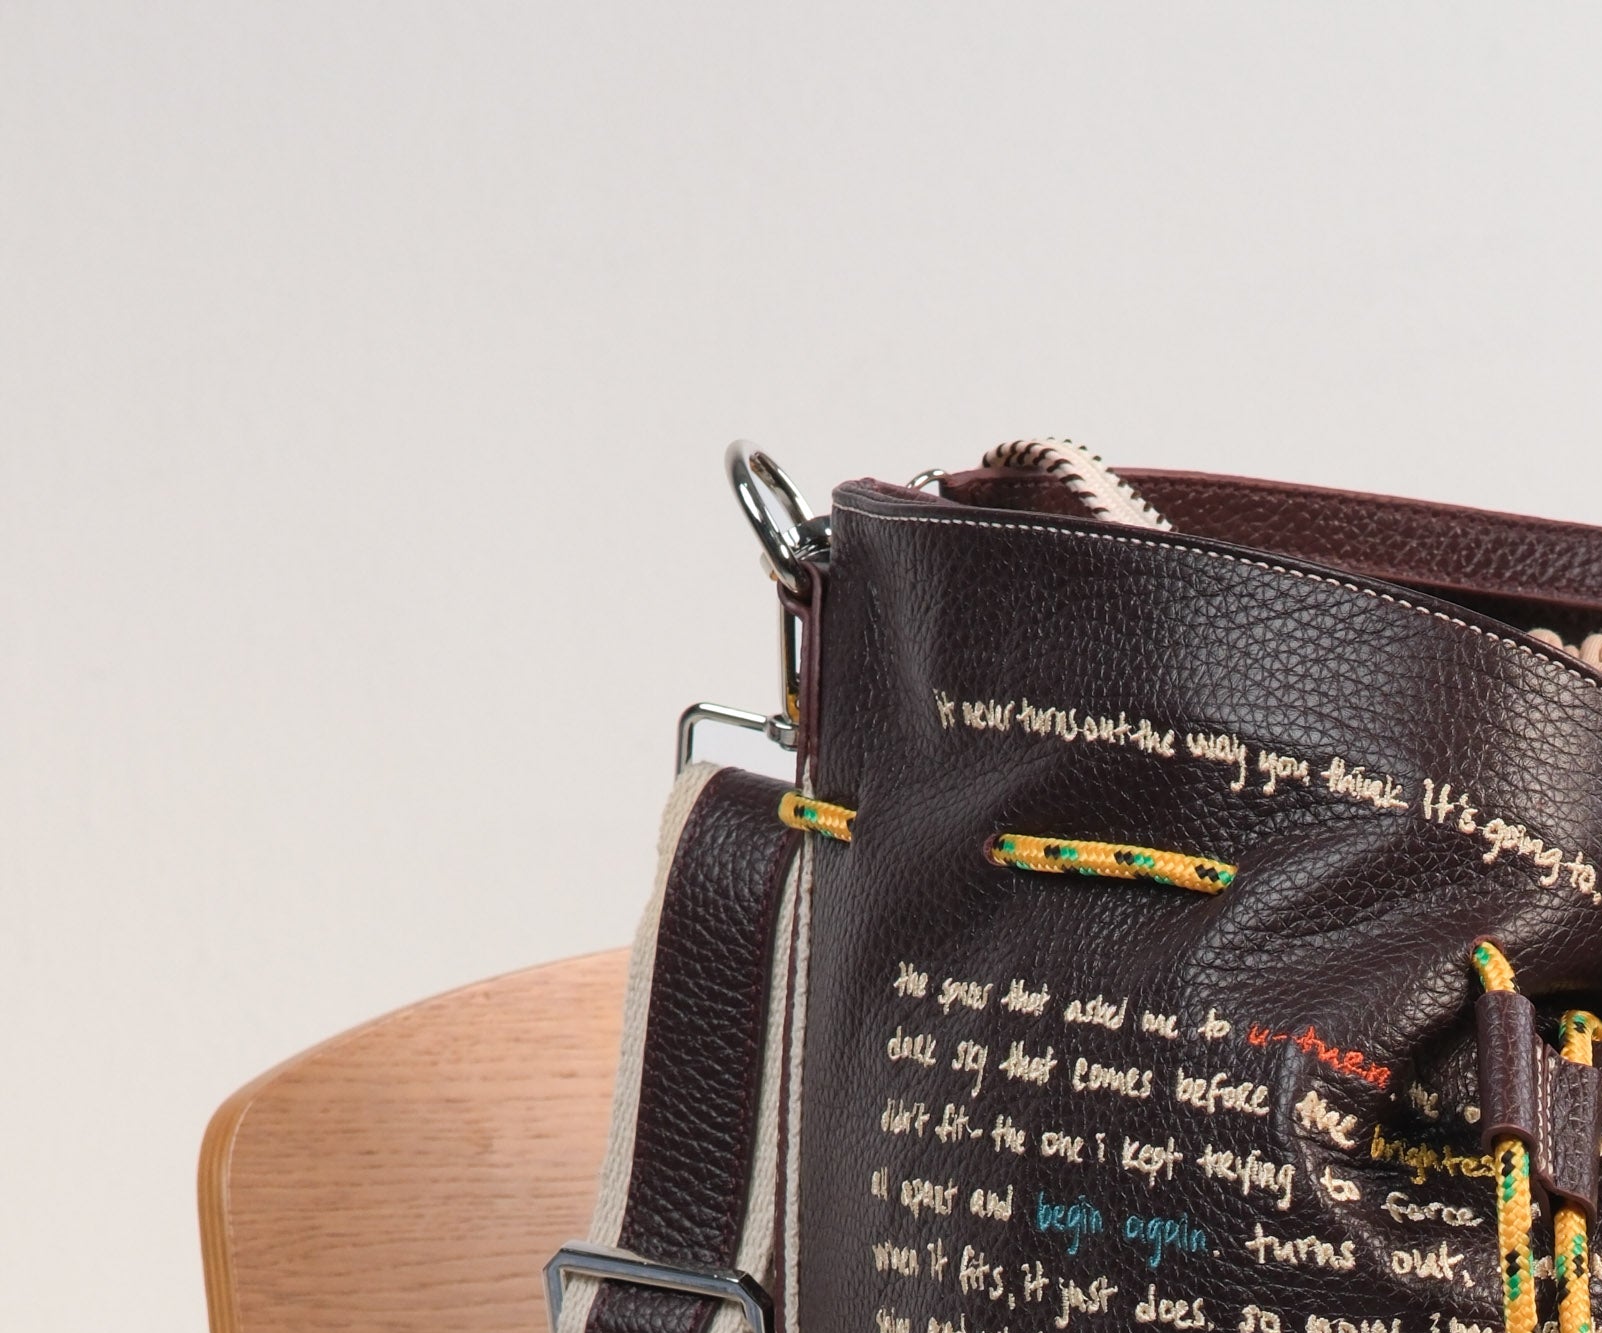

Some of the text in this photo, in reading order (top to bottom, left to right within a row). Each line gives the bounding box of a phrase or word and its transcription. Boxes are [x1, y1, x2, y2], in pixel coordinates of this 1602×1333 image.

[1187, 732, 1247, 792] way
[894, 961, 928, 998] the
[1064, 995, 1128, 1030] asked
[1142, 1010, 1178, 1039] me
[1198, 1008, 1231, 1041] to
[952, 1040, 988, 1098] sky
[999, 1041, 1057, 1086] that
[1073, 1057, 1152, 1099] comes
[1176, 1066, 1269, 1115] before
[992, 1114, 1025, 1155] the
[1122, 1136, 1183, 1187] kept
[970, 1184, 1014, 1222] and
[1035, 1192, 1102, 1255] begin
[1245, 1222, 1356, 1271] turns
[1021, 1260, 1049, 1302] it
[1055, 1275, 1118, 1329] just
